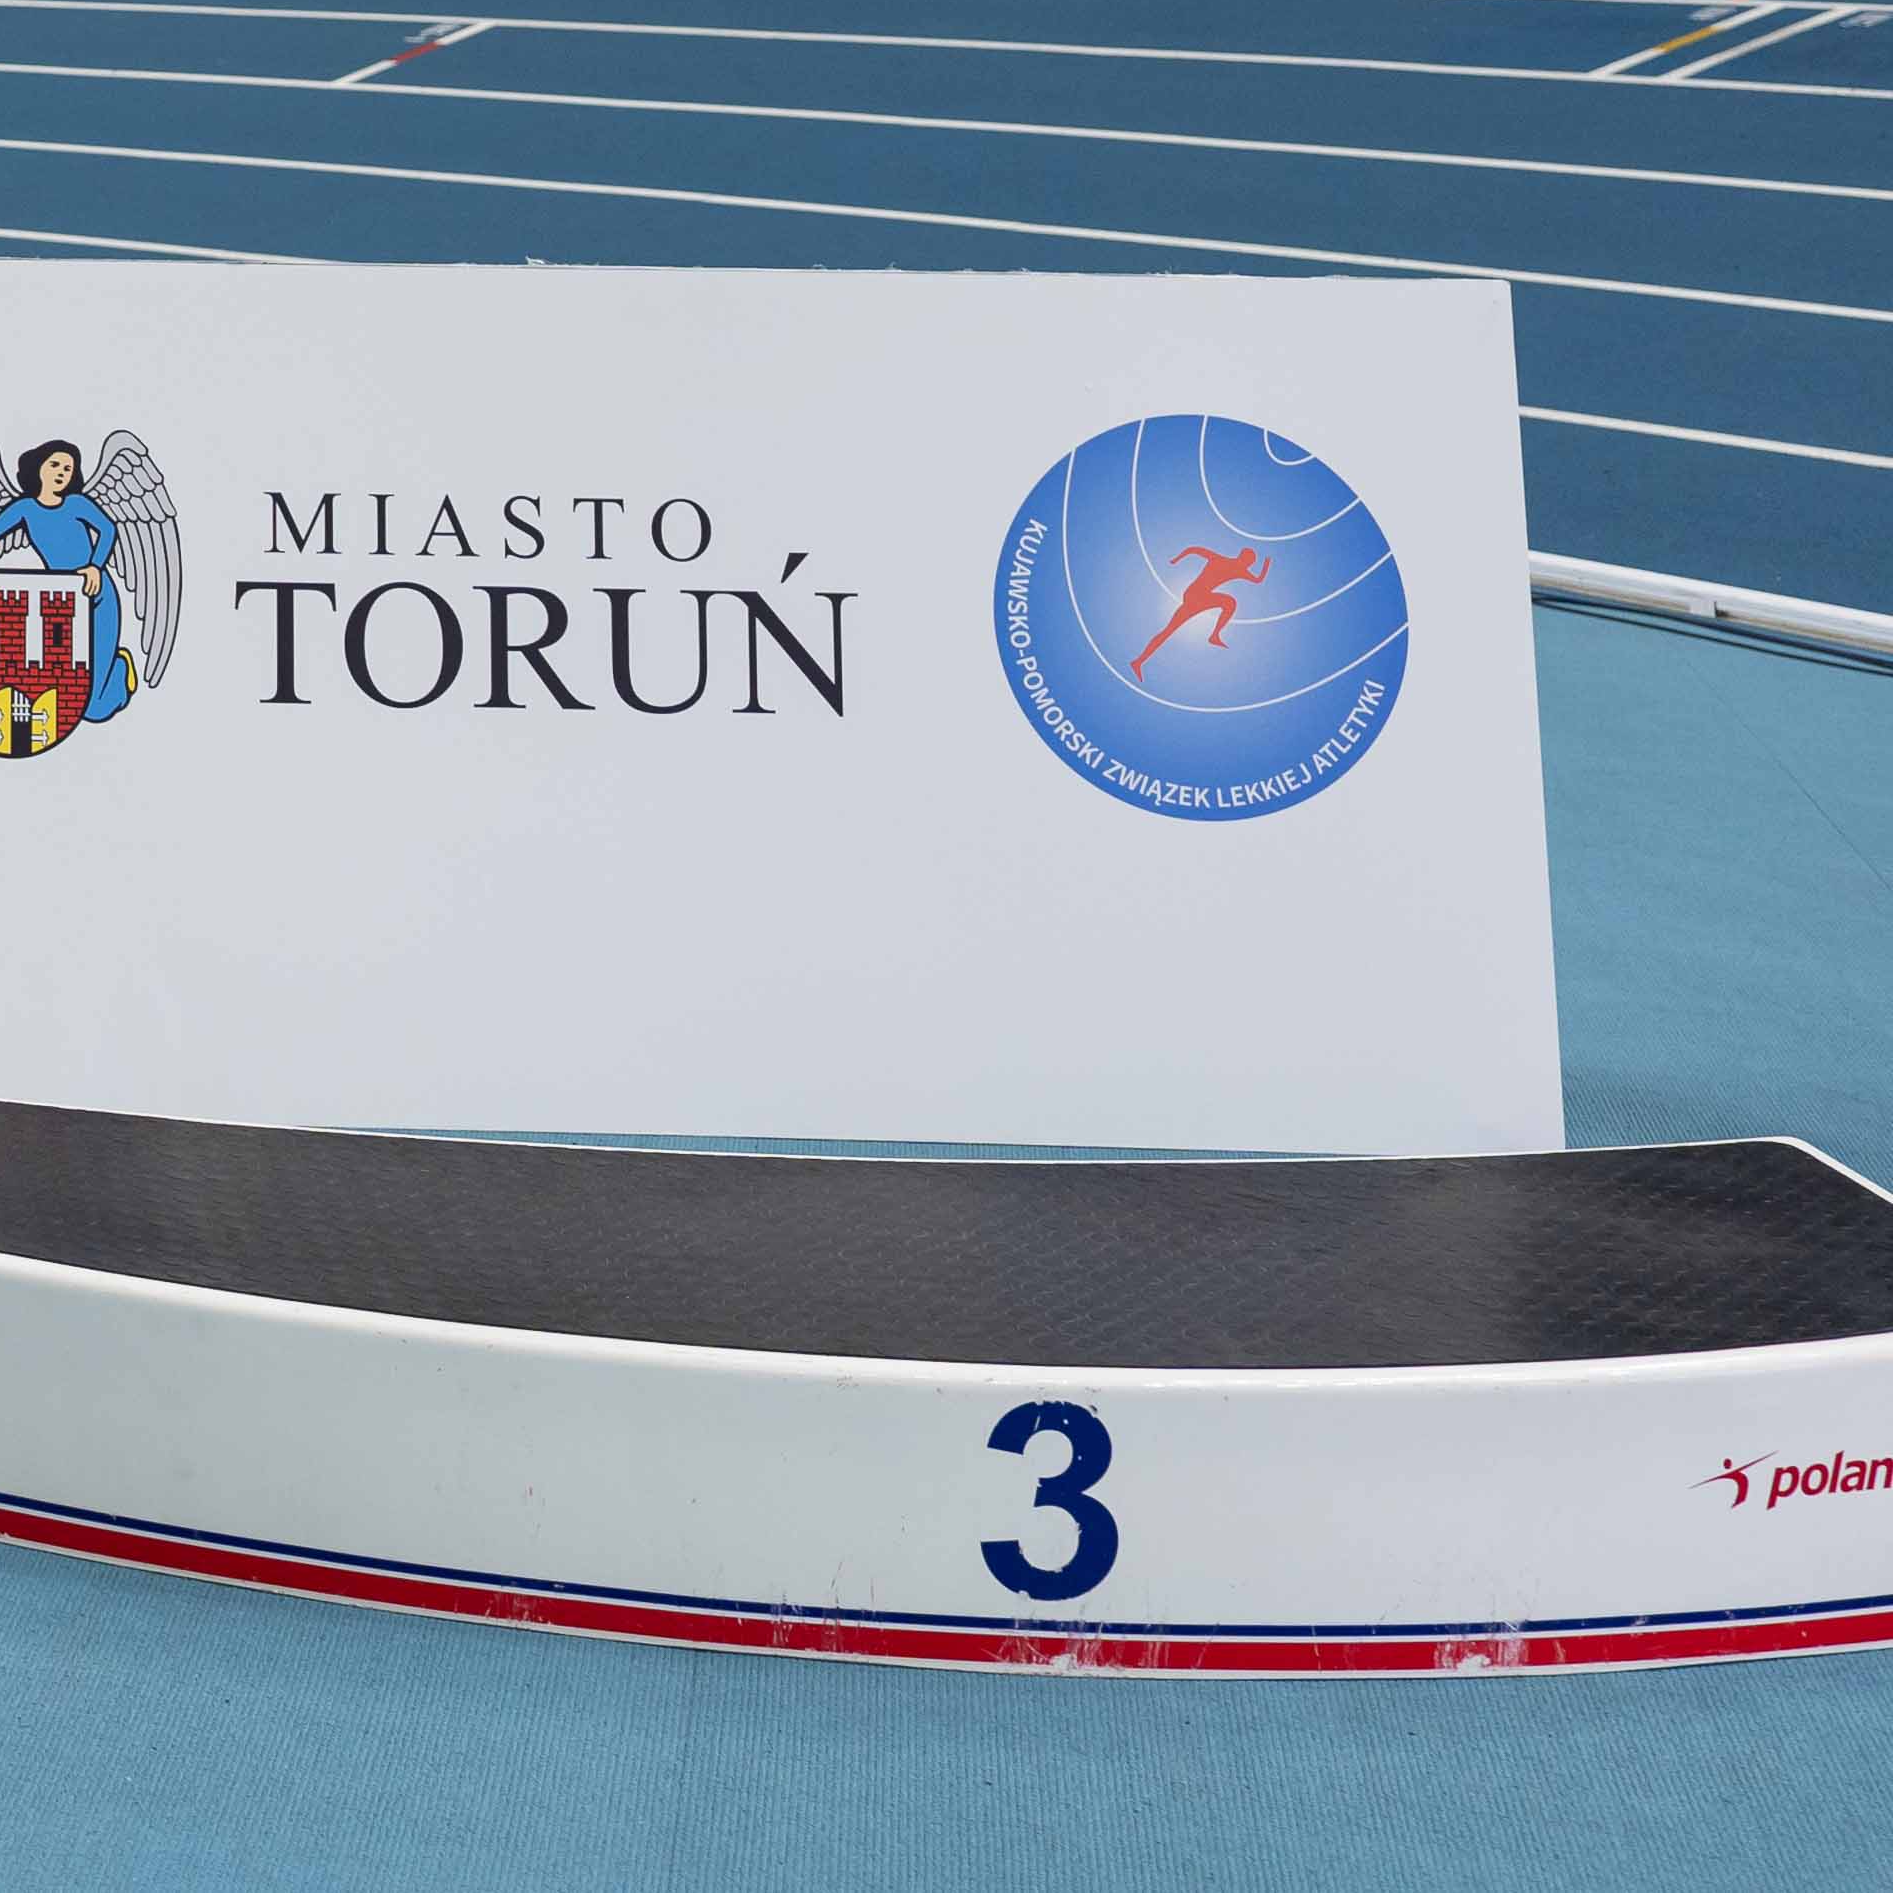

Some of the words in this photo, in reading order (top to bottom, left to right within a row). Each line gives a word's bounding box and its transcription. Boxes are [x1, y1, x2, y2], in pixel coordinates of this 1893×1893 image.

[263, 491, 713, 562] MIASTO
[234, 552, 859, 718] TORUŃ
[1006, 518, 1105, 770] KUJAWSKO-POMORSKI
[1102, 758, 1211, 810] ZWIĄZEK
[1216, 762, 1313, 810] LEKKIEJ
[1310, 679, 1386, 775] ATLETYKI
[980, 1400, 1119, 1601] 3
[1766, 1449, 1893, 1510] polan
